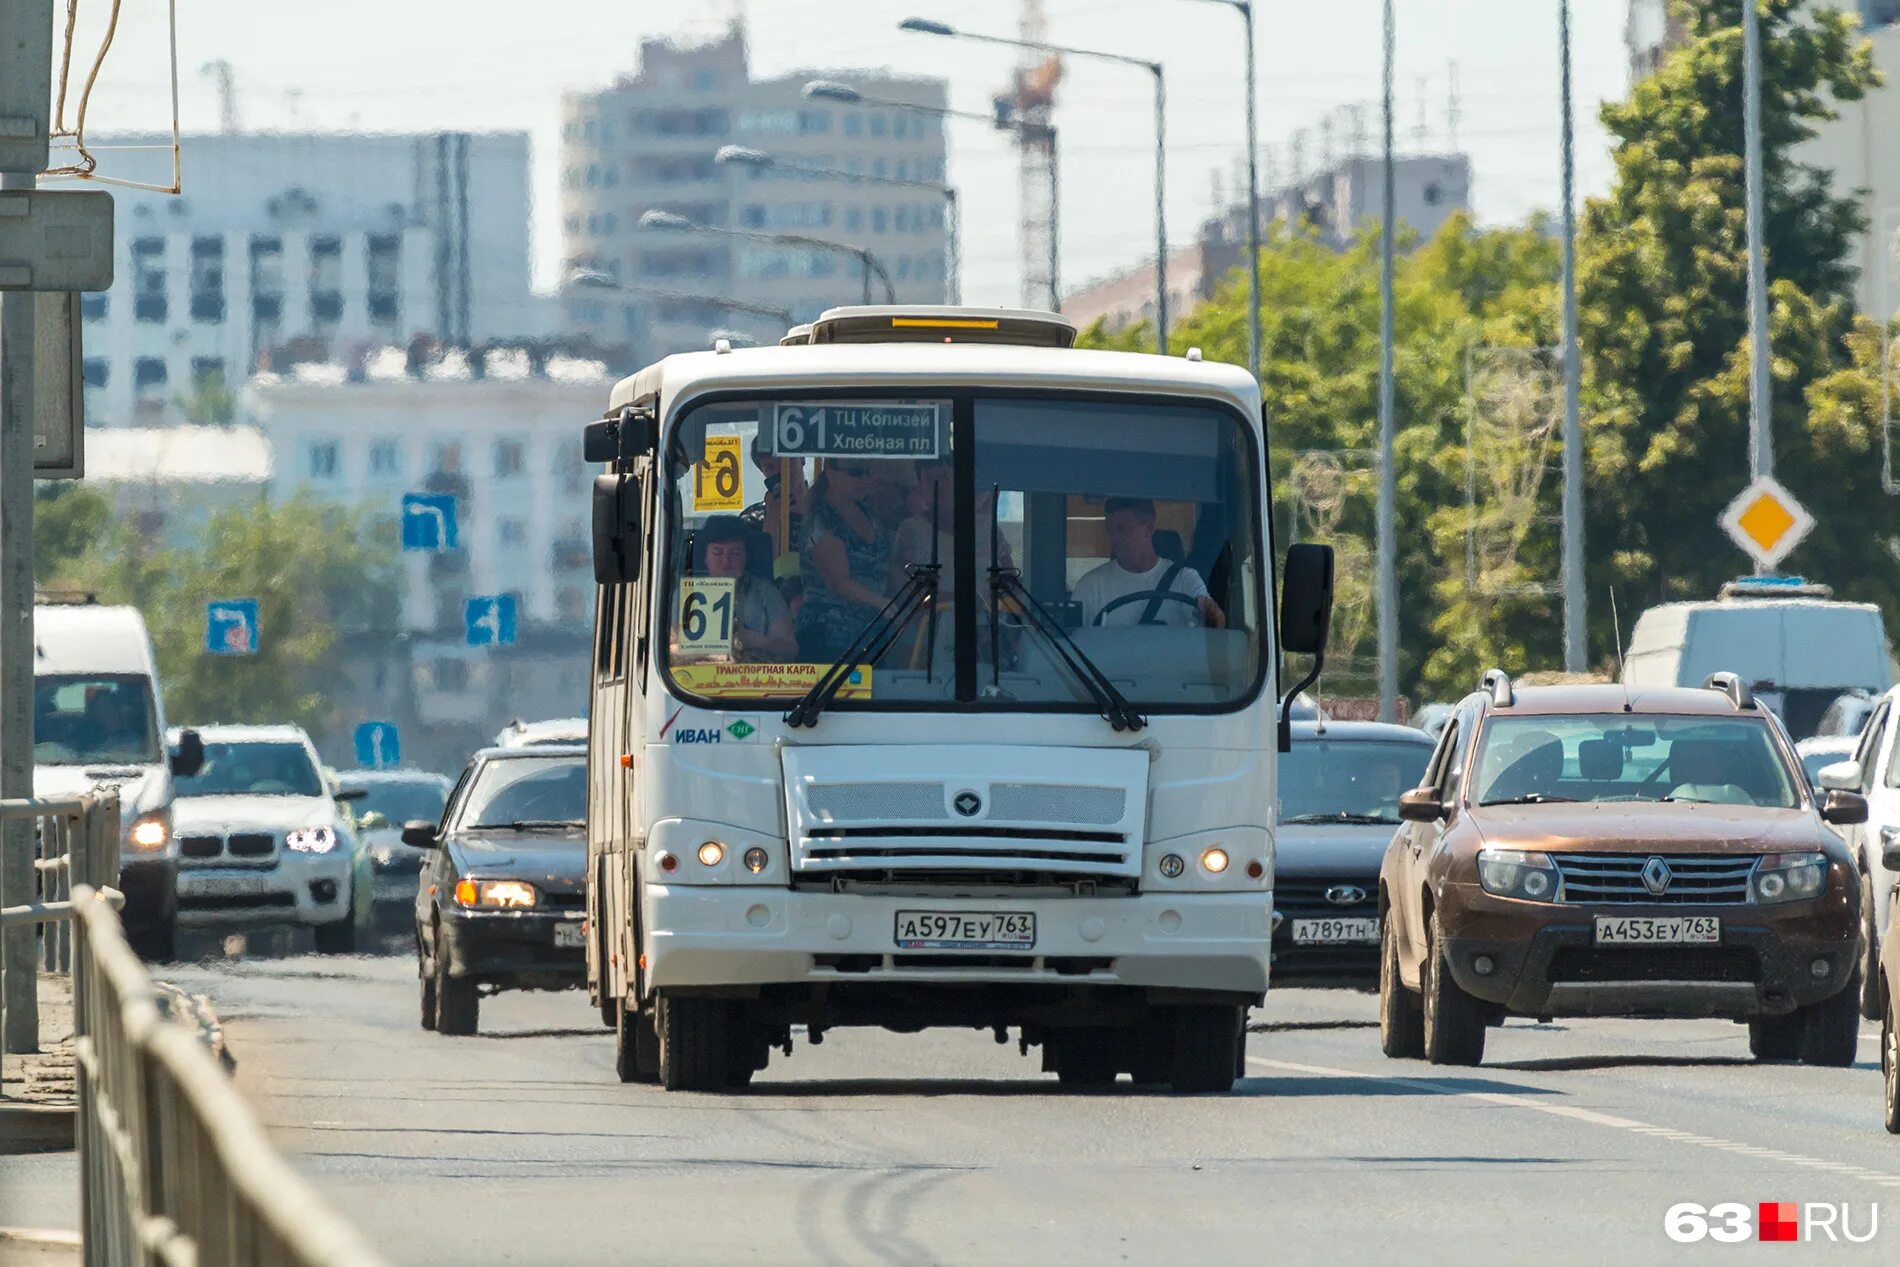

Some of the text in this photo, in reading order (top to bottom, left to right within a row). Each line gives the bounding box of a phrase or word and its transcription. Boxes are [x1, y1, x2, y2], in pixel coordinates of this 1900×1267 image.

[833, 411, 930, 427] ТЦ Колизей
[779, 407, 826, 450] 61
[833, 433, 904, 450] Хлебная
[682, 591, 731, 641] 61
[715, 665, 816, 675] ТРАНСПОРТНАЯ КАРТА
[675, 729, 721, 744] ИВАН
[904, 915, 1028, 938] А597ЕУ 763
[1299, 921, 1366, 939] А789ТН
[1602, 918, 1714, 940] А453ЕУ 763
